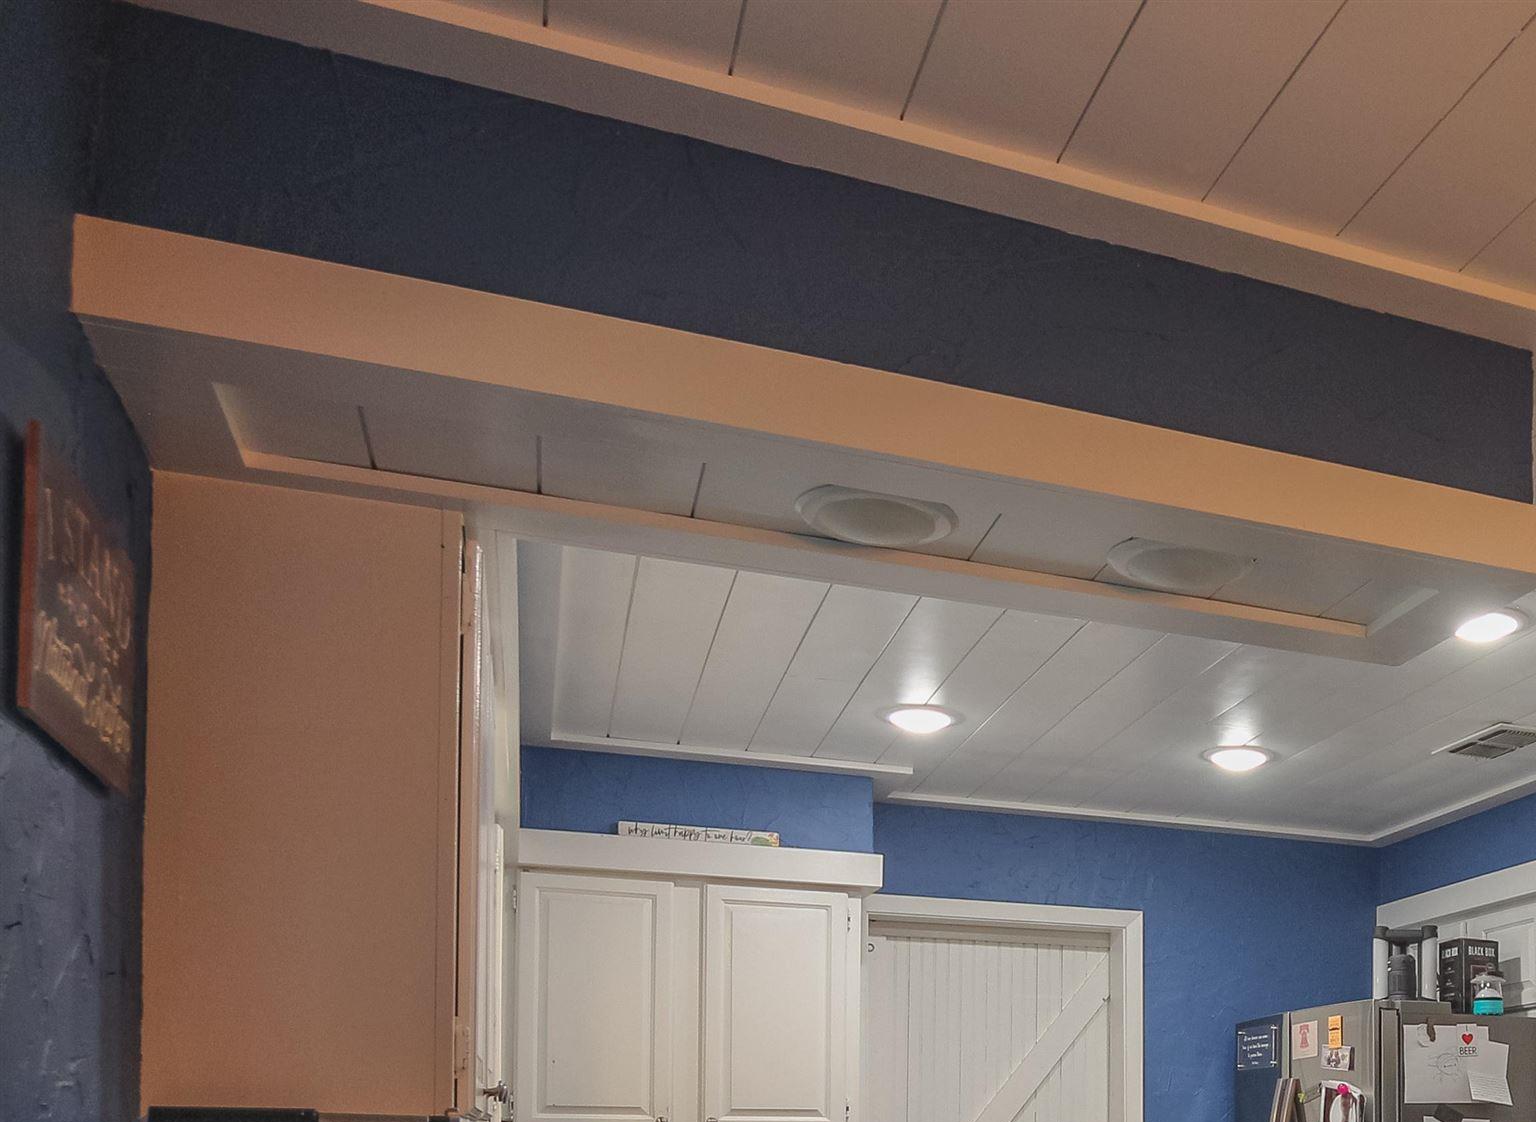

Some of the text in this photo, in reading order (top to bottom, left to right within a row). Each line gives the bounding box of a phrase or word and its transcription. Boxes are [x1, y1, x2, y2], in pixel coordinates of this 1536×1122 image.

[673, 825, 701, 841] happy
[1468, 945, 1496, 957] BLACK BOX
[1459, 1046, 1477, 1055] BEER
